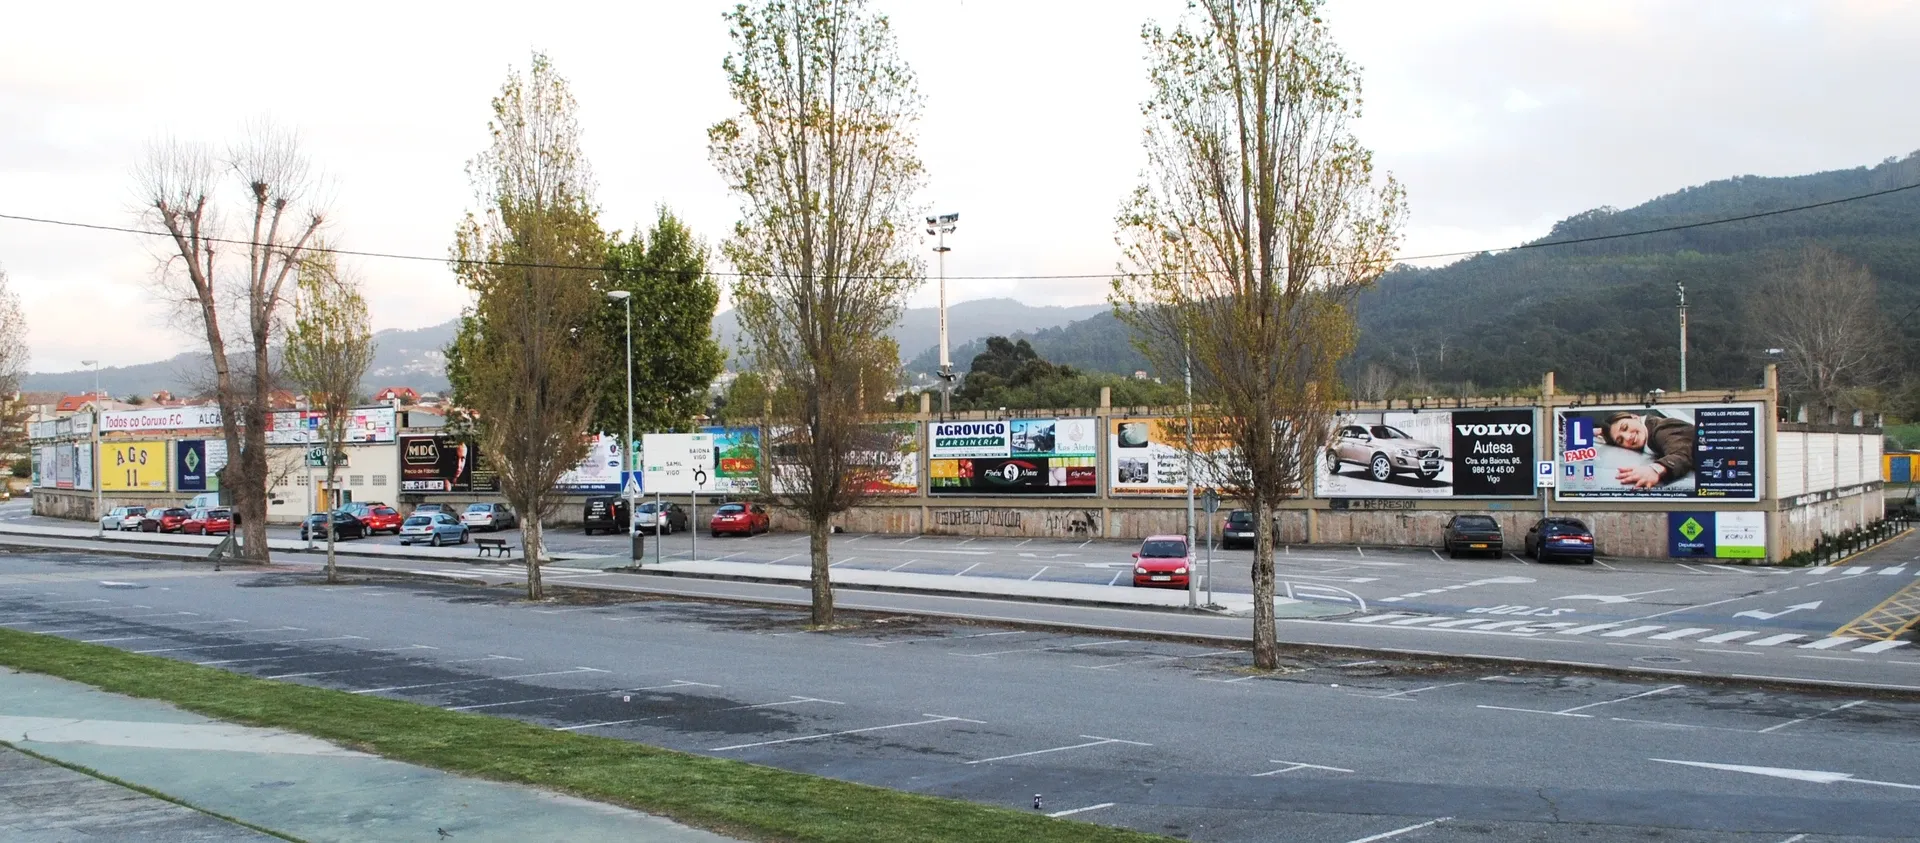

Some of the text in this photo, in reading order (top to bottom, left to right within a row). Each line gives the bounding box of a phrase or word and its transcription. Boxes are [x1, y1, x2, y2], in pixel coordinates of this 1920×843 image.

[105, 416, 127, 428] Todos
[129, 417, 139, 427] co
[141, 415, 167, 426] Coruxo
[169, 414, 184, 425] F.C.
[936, 423, 1005, 436] AGROVIGO
[1456, 423, 1531, 436] VOLVO
[1574, 421, 1587, 445] L
[408, 445, 435, 456] MDC
[1473, 440, 1514, 453] Autesa
[1465, 457, 1479, 465] Ctra.
[1489, 457, 1511, 466] Baiona,
[1565, 448, 1596, 462] FARO
[126, 469, 138, 487] 11
[1487, 475, 1500, 484] Vigo
[1698, 488, 1707, 496] 12
[1364, 500, 1417, 510] REPRESION
[1466, 604, 1576, 617] STOP
